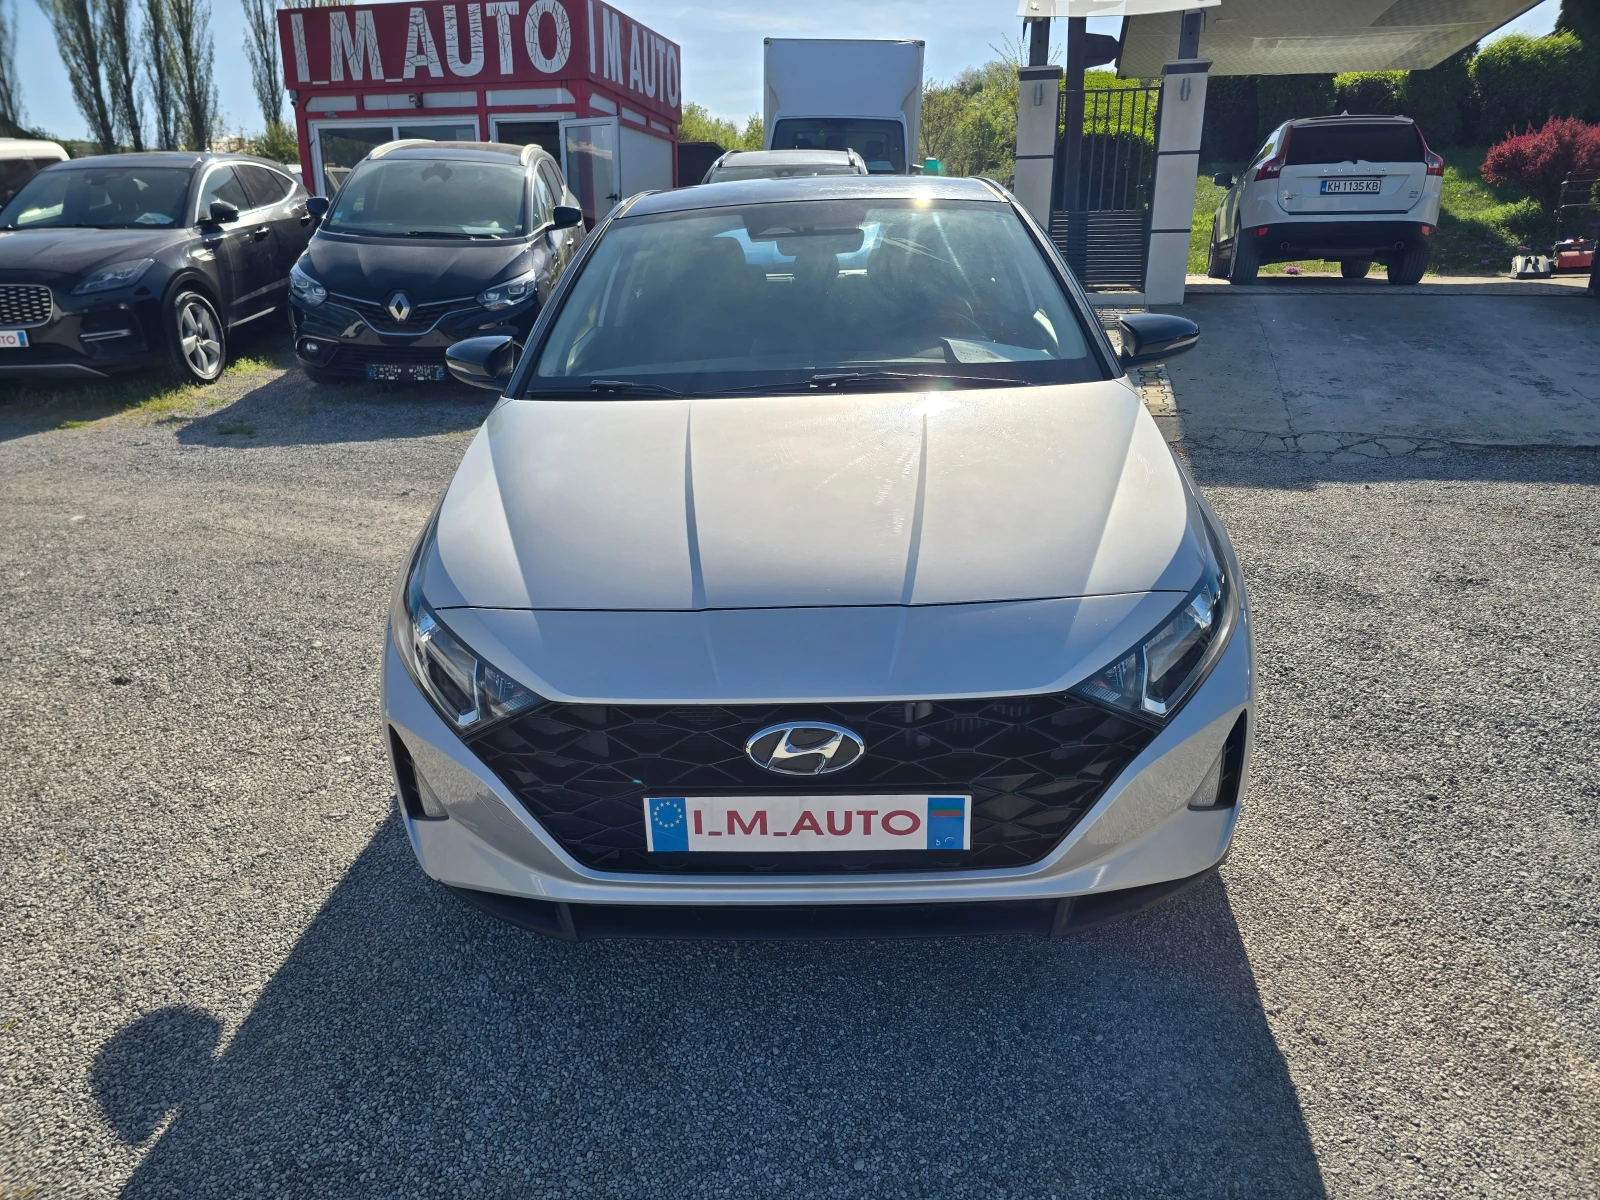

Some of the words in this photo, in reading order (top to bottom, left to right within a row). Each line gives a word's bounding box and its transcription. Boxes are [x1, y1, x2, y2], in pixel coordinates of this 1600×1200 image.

[603, 7, 623, 85] M
[629, 24, 679, 108] AUTO
[1327, 182, 1341, 191] KH
[1343, 182, 1364, 191] 1135
[1366, 181, 1378, 191] KB
[0, 335, 16, 345] TO
[693, 809, 921, 836] I_M_AUTO
